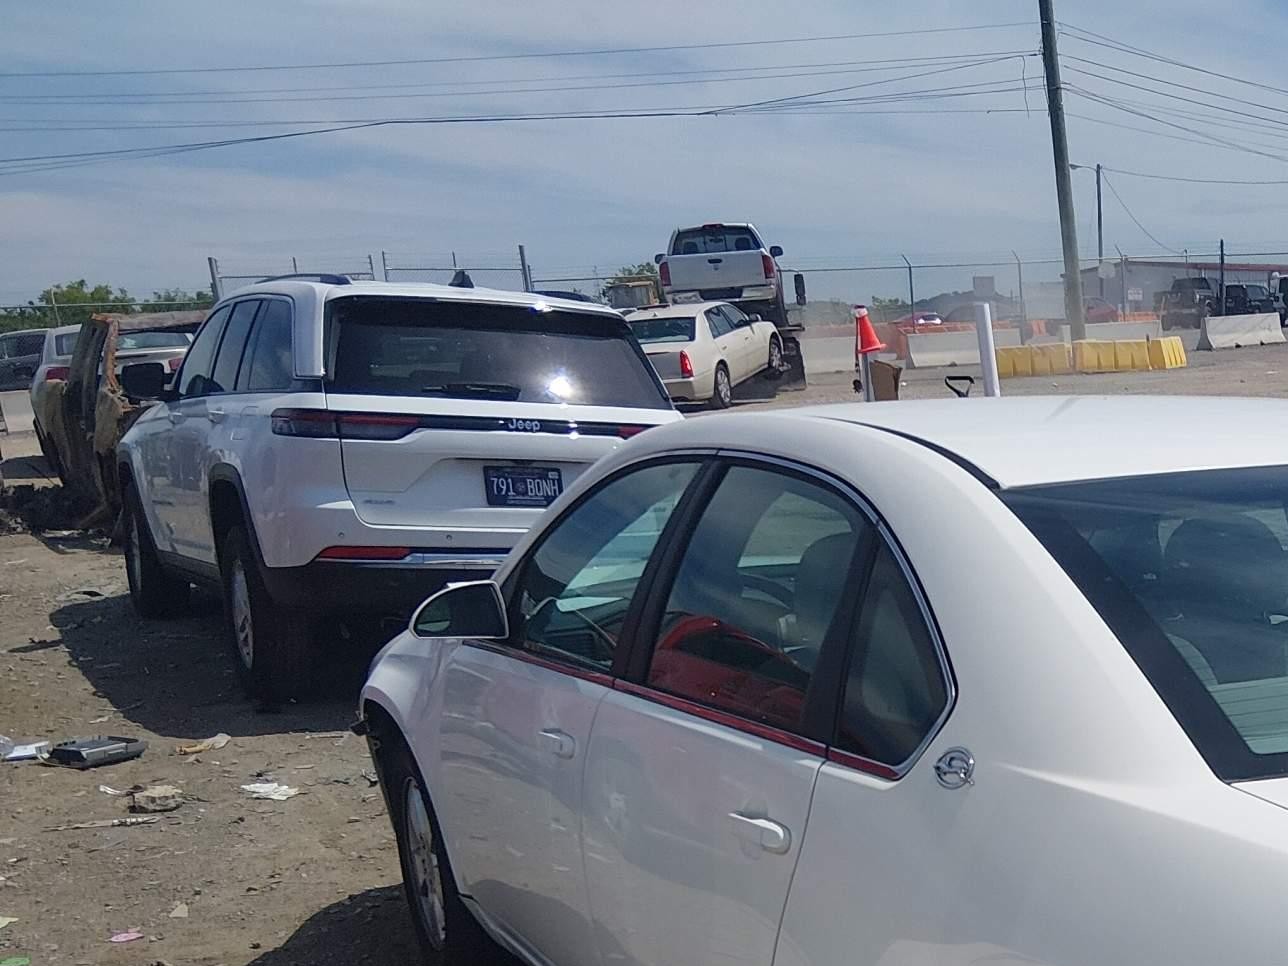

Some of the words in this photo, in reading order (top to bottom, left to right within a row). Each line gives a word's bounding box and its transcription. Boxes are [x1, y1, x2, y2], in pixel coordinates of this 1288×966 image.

[508, 418, 541, 433] Jeep
[490, 477, 517, 496] 791
[526, 478, 560, 497] BONH
